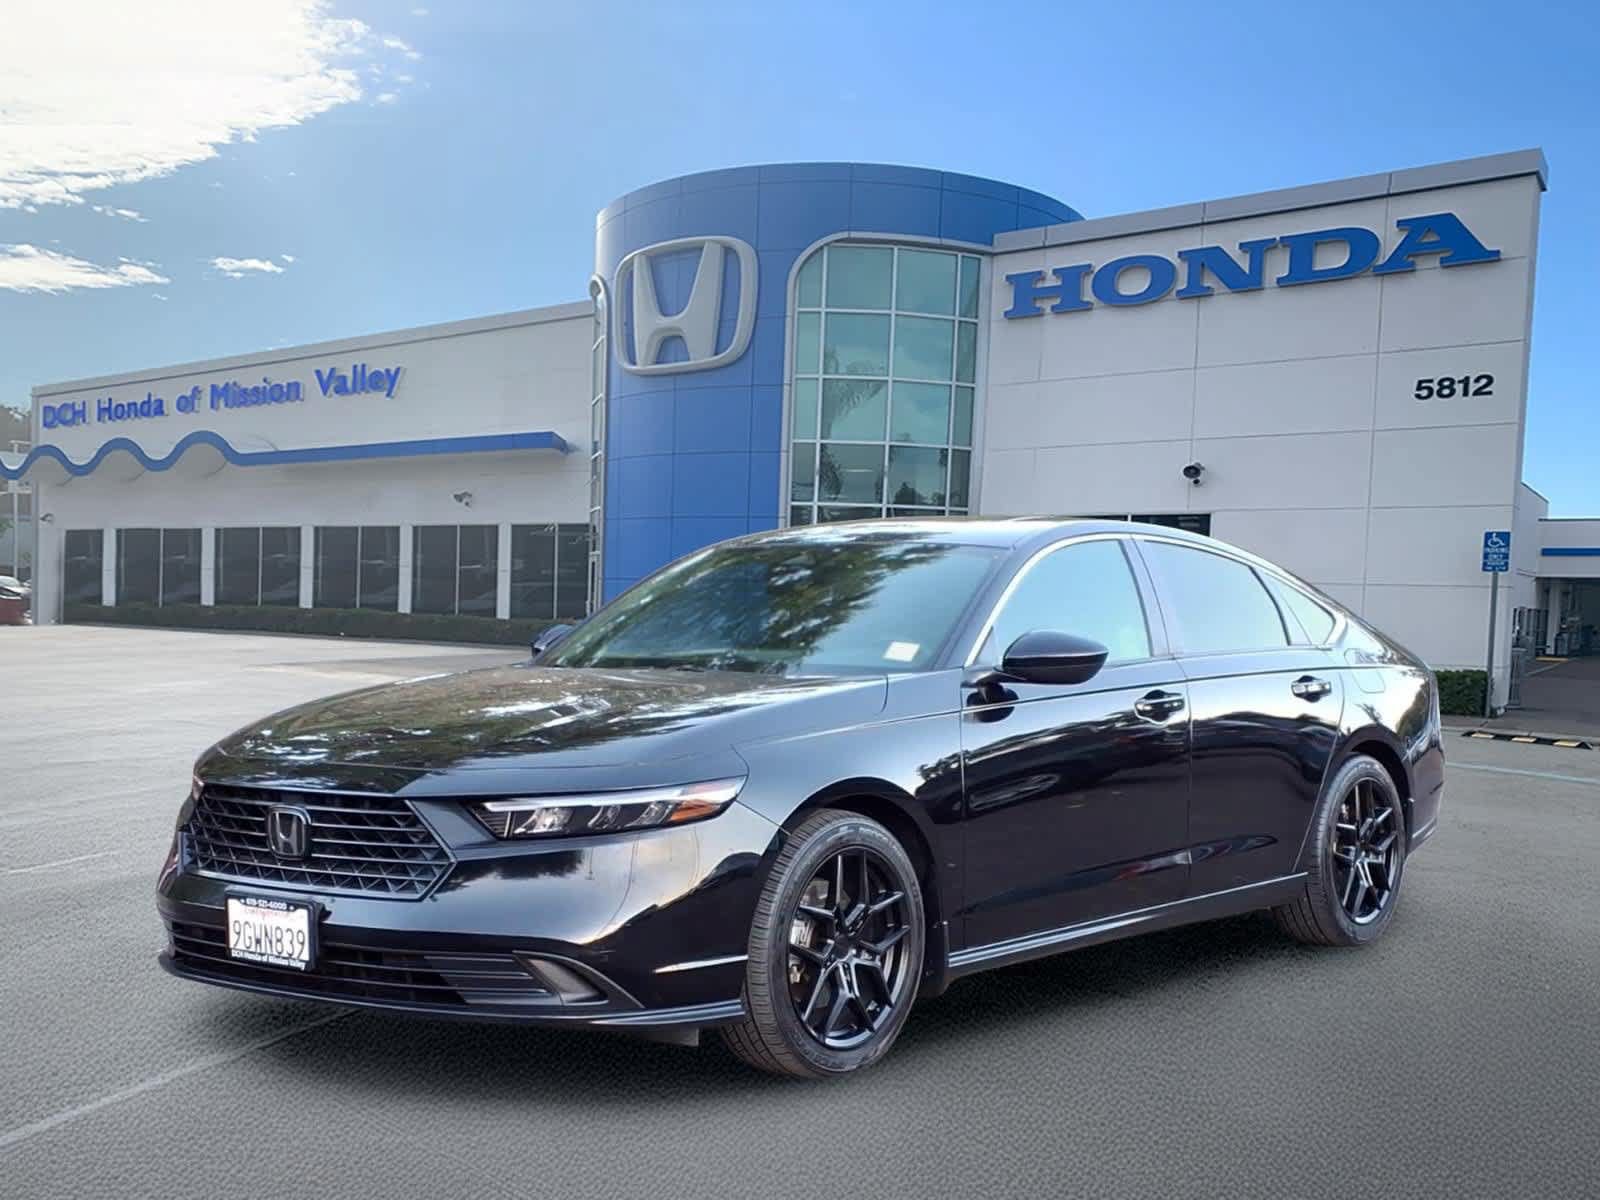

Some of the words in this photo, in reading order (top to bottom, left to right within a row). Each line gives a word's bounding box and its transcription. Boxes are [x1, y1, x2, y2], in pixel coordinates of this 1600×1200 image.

[1003, 212, 1501, 319] HONDA
[42, 402, 87, 429] DCH
[96, 392, 166, 423] Honda
[176, 386, 200, 413] of
[209, 378, 302, 410] Mission
[314, 363, 401, 398] Valley
[1414, 374, 1495, 400] 5812
[232, 919, 306, 961] 9GWN839
